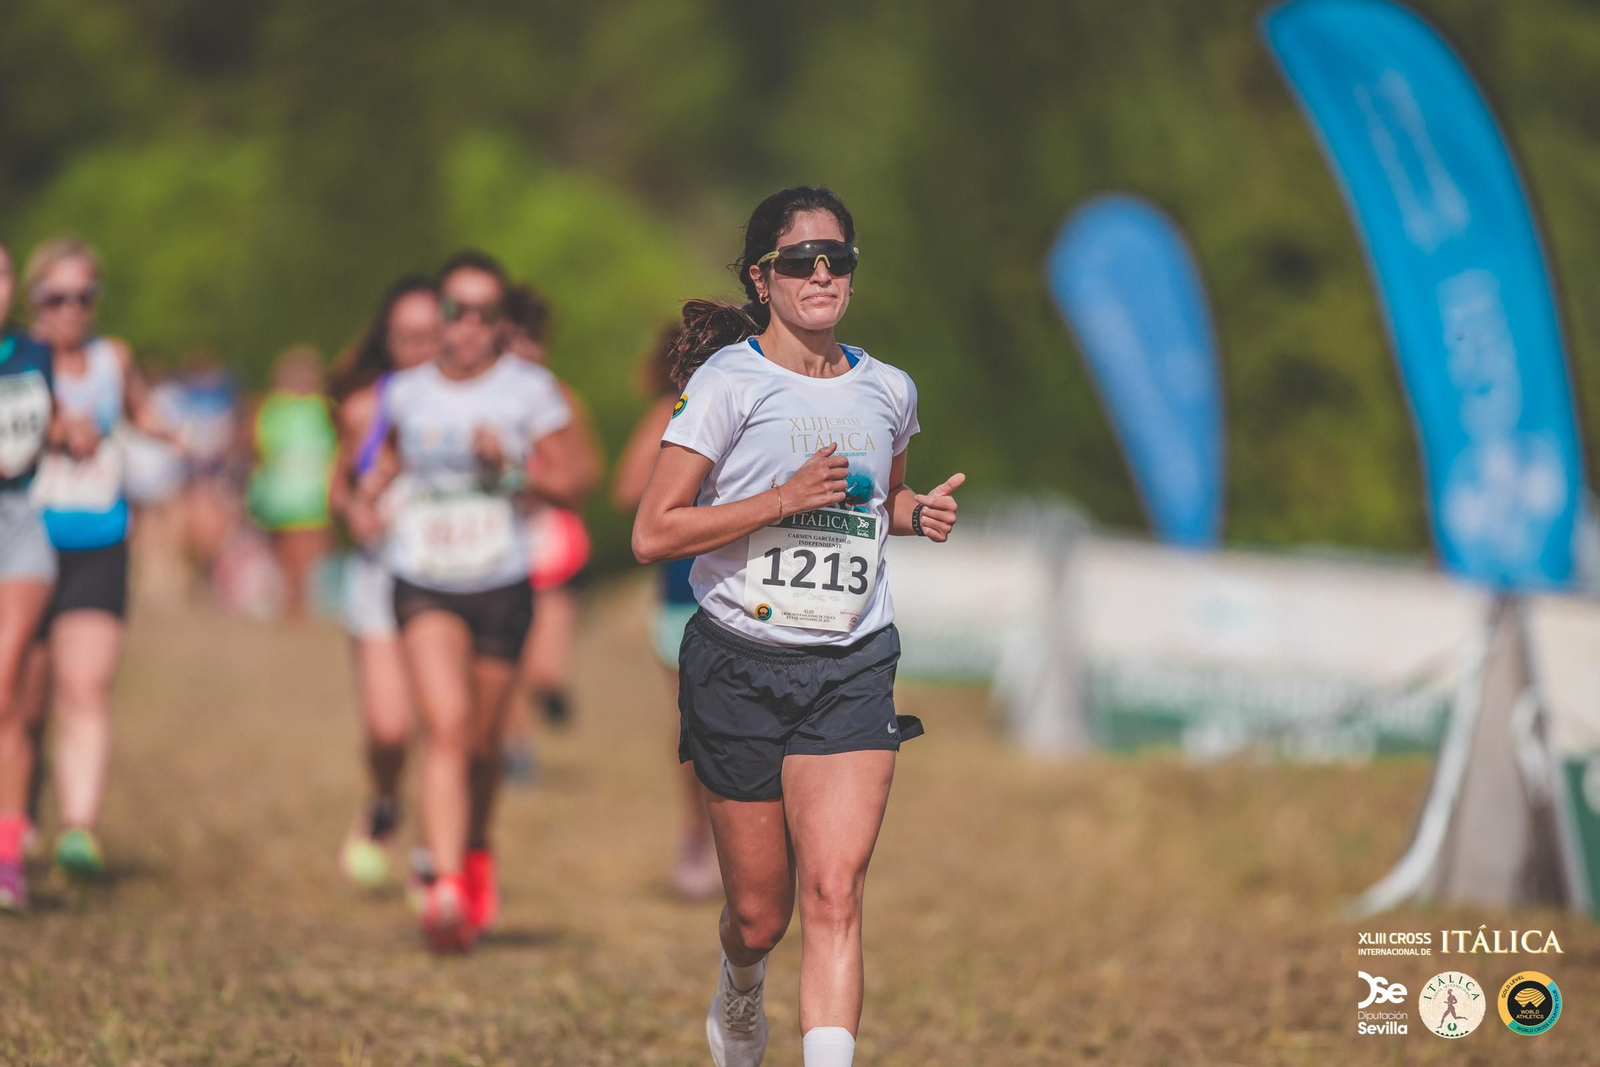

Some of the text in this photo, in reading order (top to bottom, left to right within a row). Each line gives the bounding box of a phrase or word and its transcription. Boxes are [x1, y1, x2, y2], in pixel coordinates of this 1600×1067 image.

[789, 416, 830, 431] XLIII
[828, 416, 861, 426] CROSS
[791, 511, 849, 531] ITÁLICA
[798, 540, 842, 549] INDEPENDIENTE
[762, 547, 868, 595] 1213
